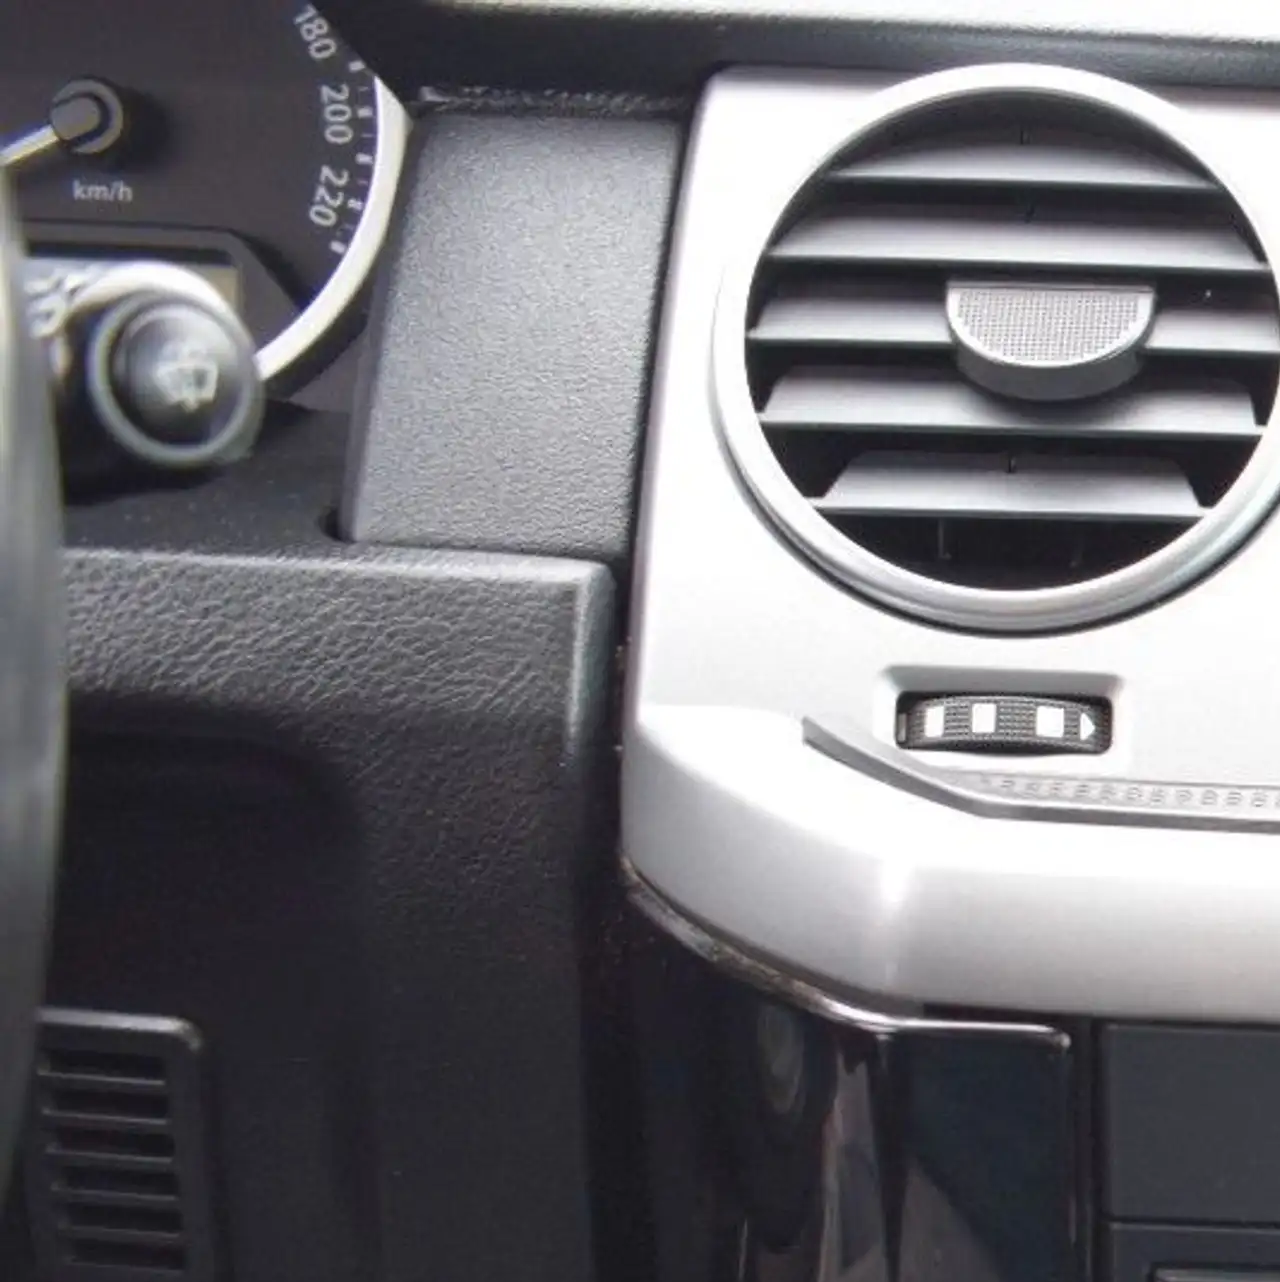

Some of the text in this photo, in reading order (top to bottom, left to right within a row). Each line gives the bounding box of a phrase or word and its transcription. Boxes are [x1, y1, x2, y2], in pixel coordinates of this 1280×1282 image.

[294, 4, 337, 59] 180
[320, 84, 353, 144] 200
[72, 180, 132, 201] km/h
[309, 165, 349, 227] 220
